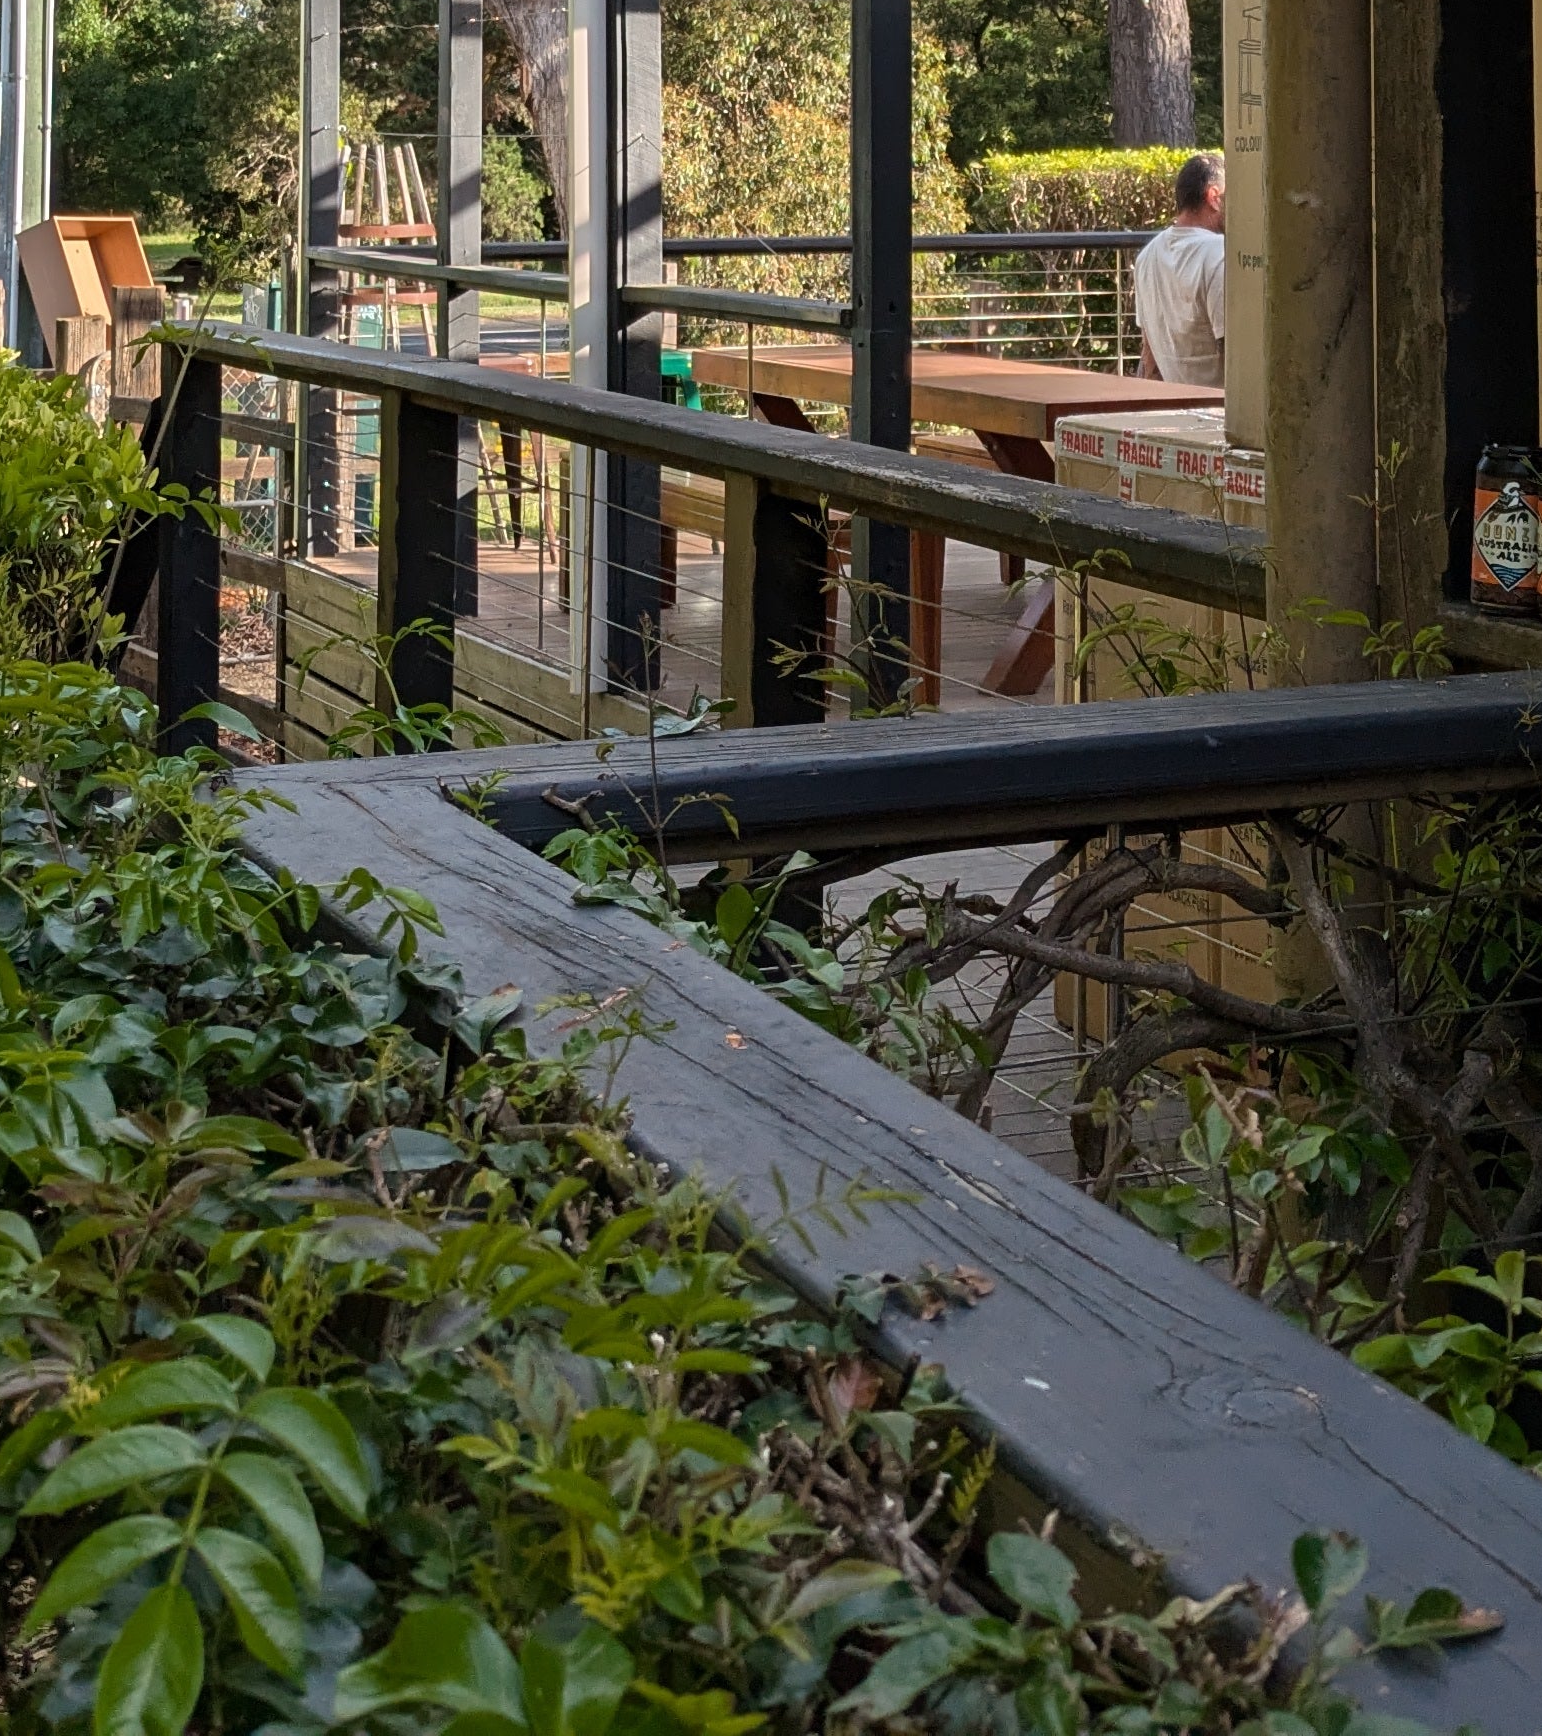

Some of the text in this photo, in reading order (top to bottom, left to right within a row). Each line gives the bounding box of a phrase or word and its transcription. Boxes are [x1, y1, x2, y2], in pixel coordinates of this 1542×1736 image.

[1061, 430, 1163, 469] FRAGILE FRAGILE
[1497, 552, 1520, 562] ALE
